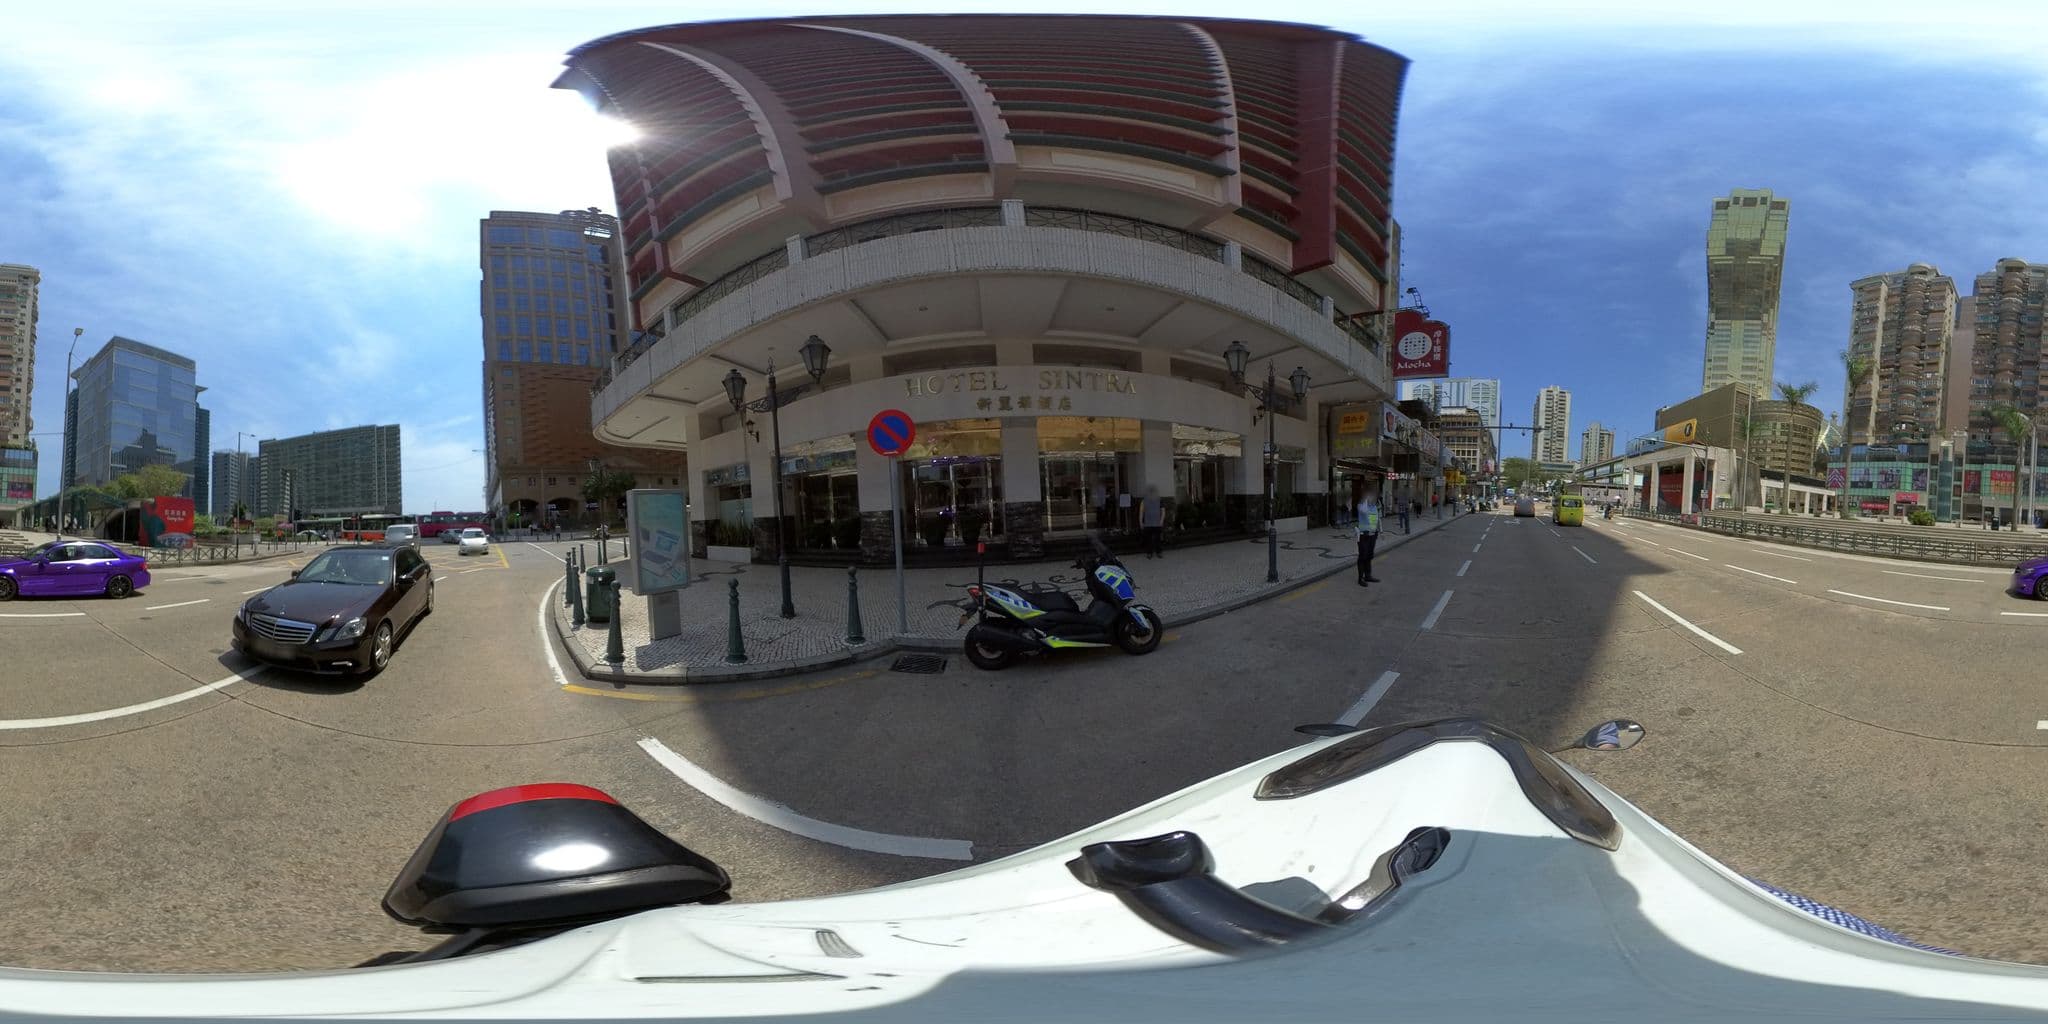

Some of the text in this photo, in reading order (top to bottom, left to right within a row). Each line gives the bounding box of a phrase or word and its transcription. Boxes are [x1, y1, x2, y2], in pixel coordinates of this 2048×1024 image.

[1397, 360, 1431, 369] Mocha
[905, 370, 1136, 397] HOTEL SINTRA
